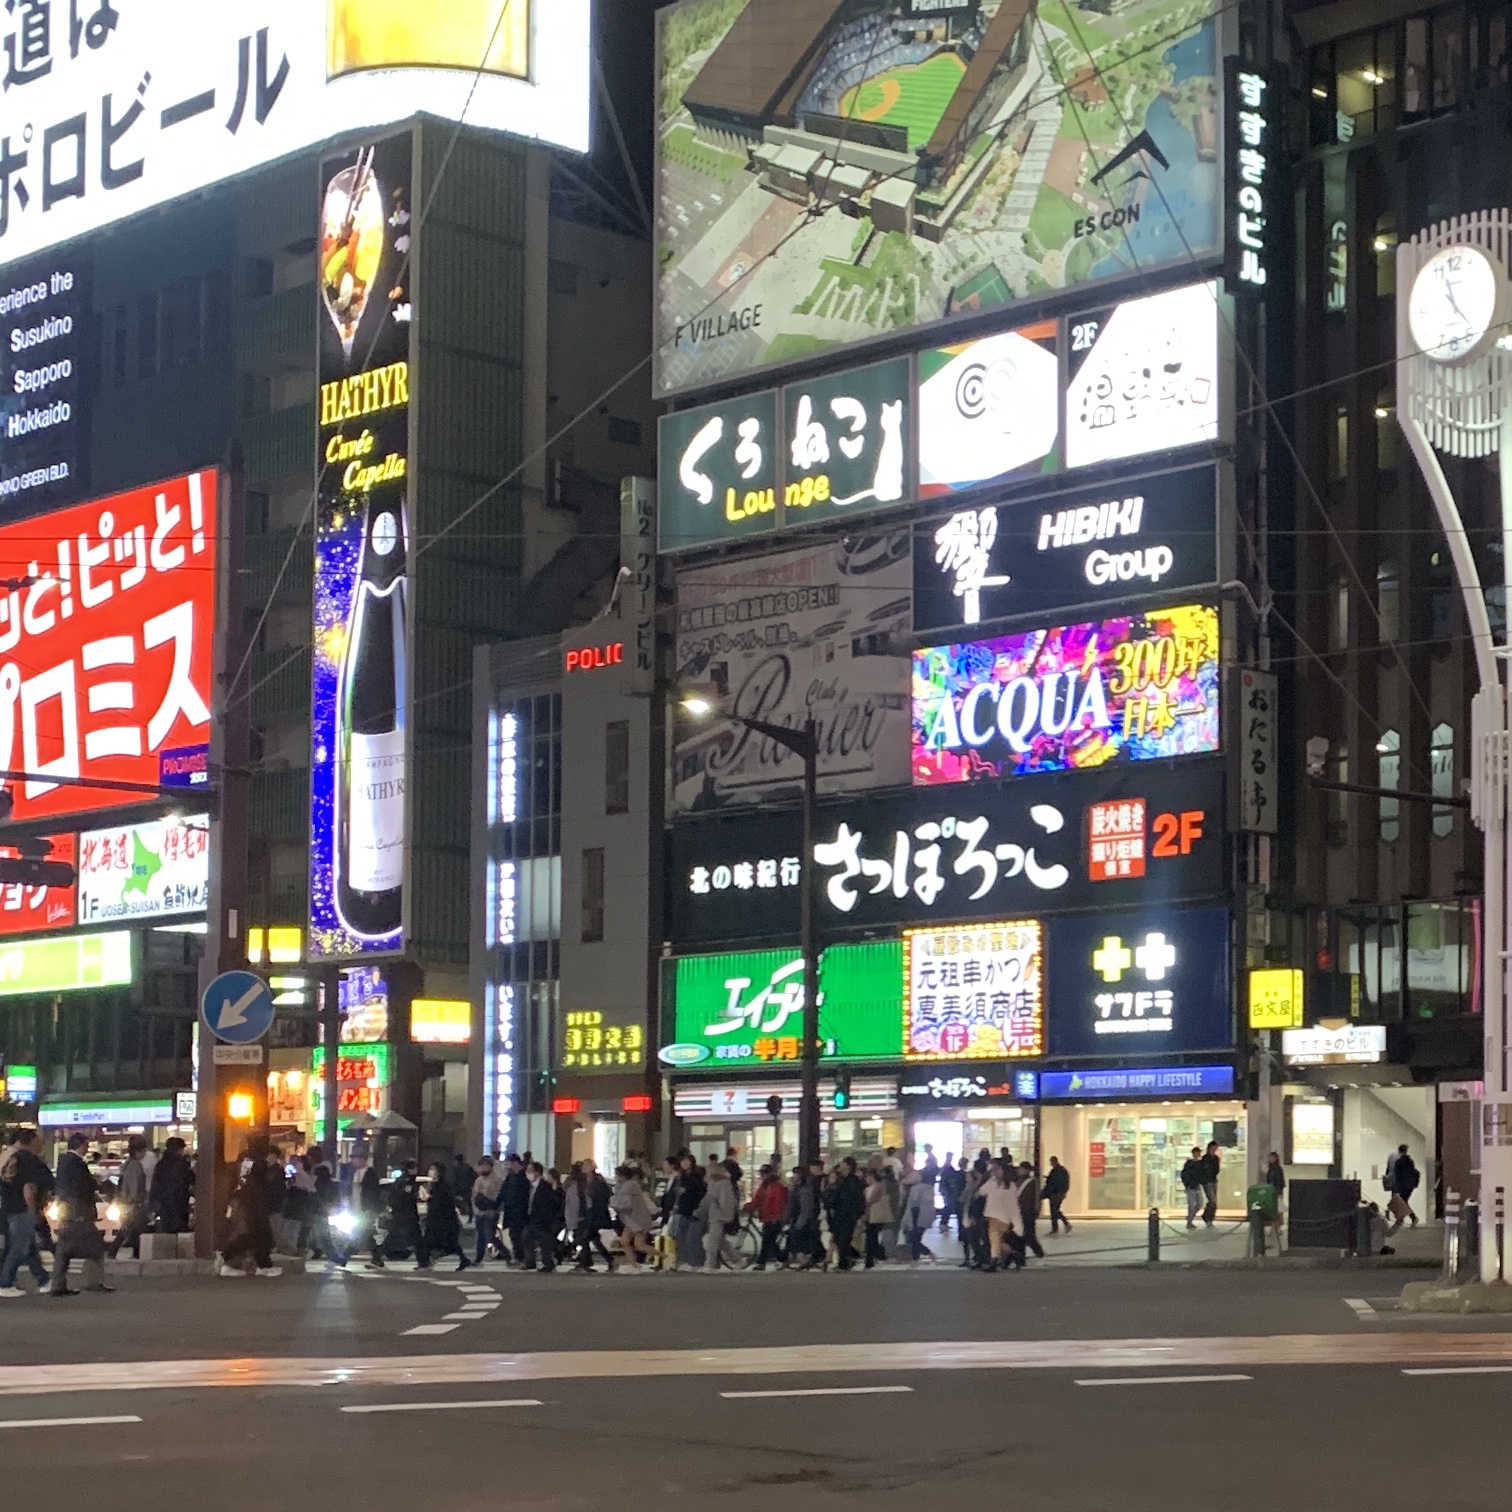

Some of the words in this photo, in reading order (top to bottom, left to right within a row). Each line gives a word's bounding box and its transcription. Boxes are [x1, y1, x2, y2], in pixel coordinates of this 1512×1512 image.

[1239, 72, 1266, 285] すすきのビル
[0, 281, 47, 315] erience
[50, 271, 73, 295] the
[11, 315, 72, 353] Susukino
[690, 303, 764, 344] VILLAGE
[1072, 322, 1098, 350] 2F
[14, 359, 72, 393] Sapporo
[320, 361, 409, 425] HATHYR
[8, 400, 70, 438] Hokkaido
[325, 428, 374, 464] Cuvée
[680, 394, 867, 504] くろねこ
[343, 452, 407, 492] Capella
[726, 475, 830, 522] Lounge
[1037, 496, 1145, 551] HIBIKI
[1085, 544, 1174, 585] Group
[1110, 634, 1206, 694] 300坪
[925, 667, 1113, 752] ACQUA
[1122, 692, 1206, 740] 日本一
[1091, 803, 1145, 836] 炭火焼き
[1152, 810, 1205, 858] 2F
[82, 832, 129, 875] 北海道
[813, 803, 1069, 912] さっぽろっこ
[690, 856, 802, 895] 北の味紀行
[81, 890, 100, 920] 1F
[917, 957, 1021, 988] 元祖串かつ
[918, 988, 1035, 1023] 恵美須商店
[946, 1036, 963, 1051] 1F
[1158, 1071, 1203, 1087] LIFESTYLE
